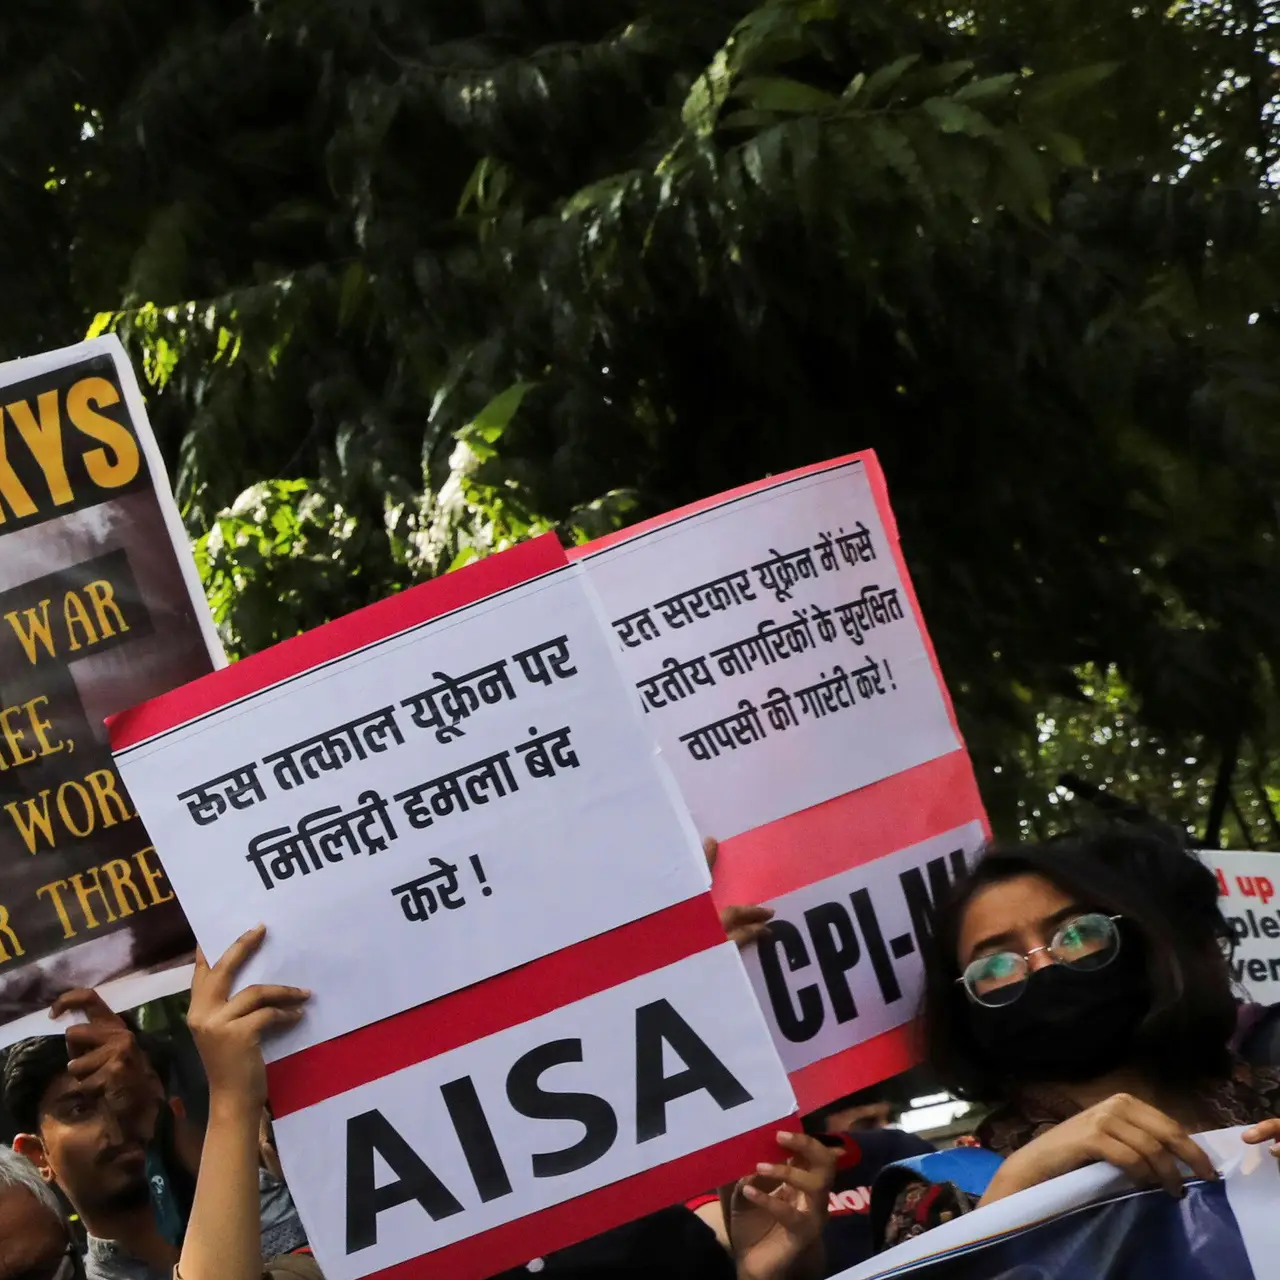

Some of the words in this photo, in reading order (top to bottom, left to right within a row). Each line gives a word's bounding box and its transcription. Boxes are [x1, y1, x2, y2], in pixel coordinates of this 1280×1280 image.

[4, 579, 130, 666] WAR
[612, 608, 661, 651] रत
[654, 570, 756, 630] सरकार
[752, 547, 818, 602] यूक्रेन
[814, 531, 840, 572] में
[636, 657, 716, 713] रतीय
[710, 608, 816, 677] नागरिकों
[811, 604, 836, 643] के
[835, 585, 904, 646] सुरक्षित
[177, 761, 267, 826] रूस
[263, 706, 404, 790] तत्काल
[401, 659, 517, 743] यूक्रेन
[514, 635, 578, 686] पर
[679, 699, 767, 762] वापसी
[761, 687, 799, 731] की
[794, 665, 856, 719] गारंटी
[851, 655, 882, 700] करे
[5, 767, 138, 857] WOR
[246, 789, 398, 890] मिलिट्री
[394, 751, 519, 829] हमला
[515, 726, 580, 778] बंद
[38, 845, 177, 939] THRE
[391, 857, 465, 923] करे
[469, 854, 492, 897] !
[1236, 876, 1274, 904] up
[757, 848, 965, 1043] CPI-M
[345, 997, 753, 1255] AISA
